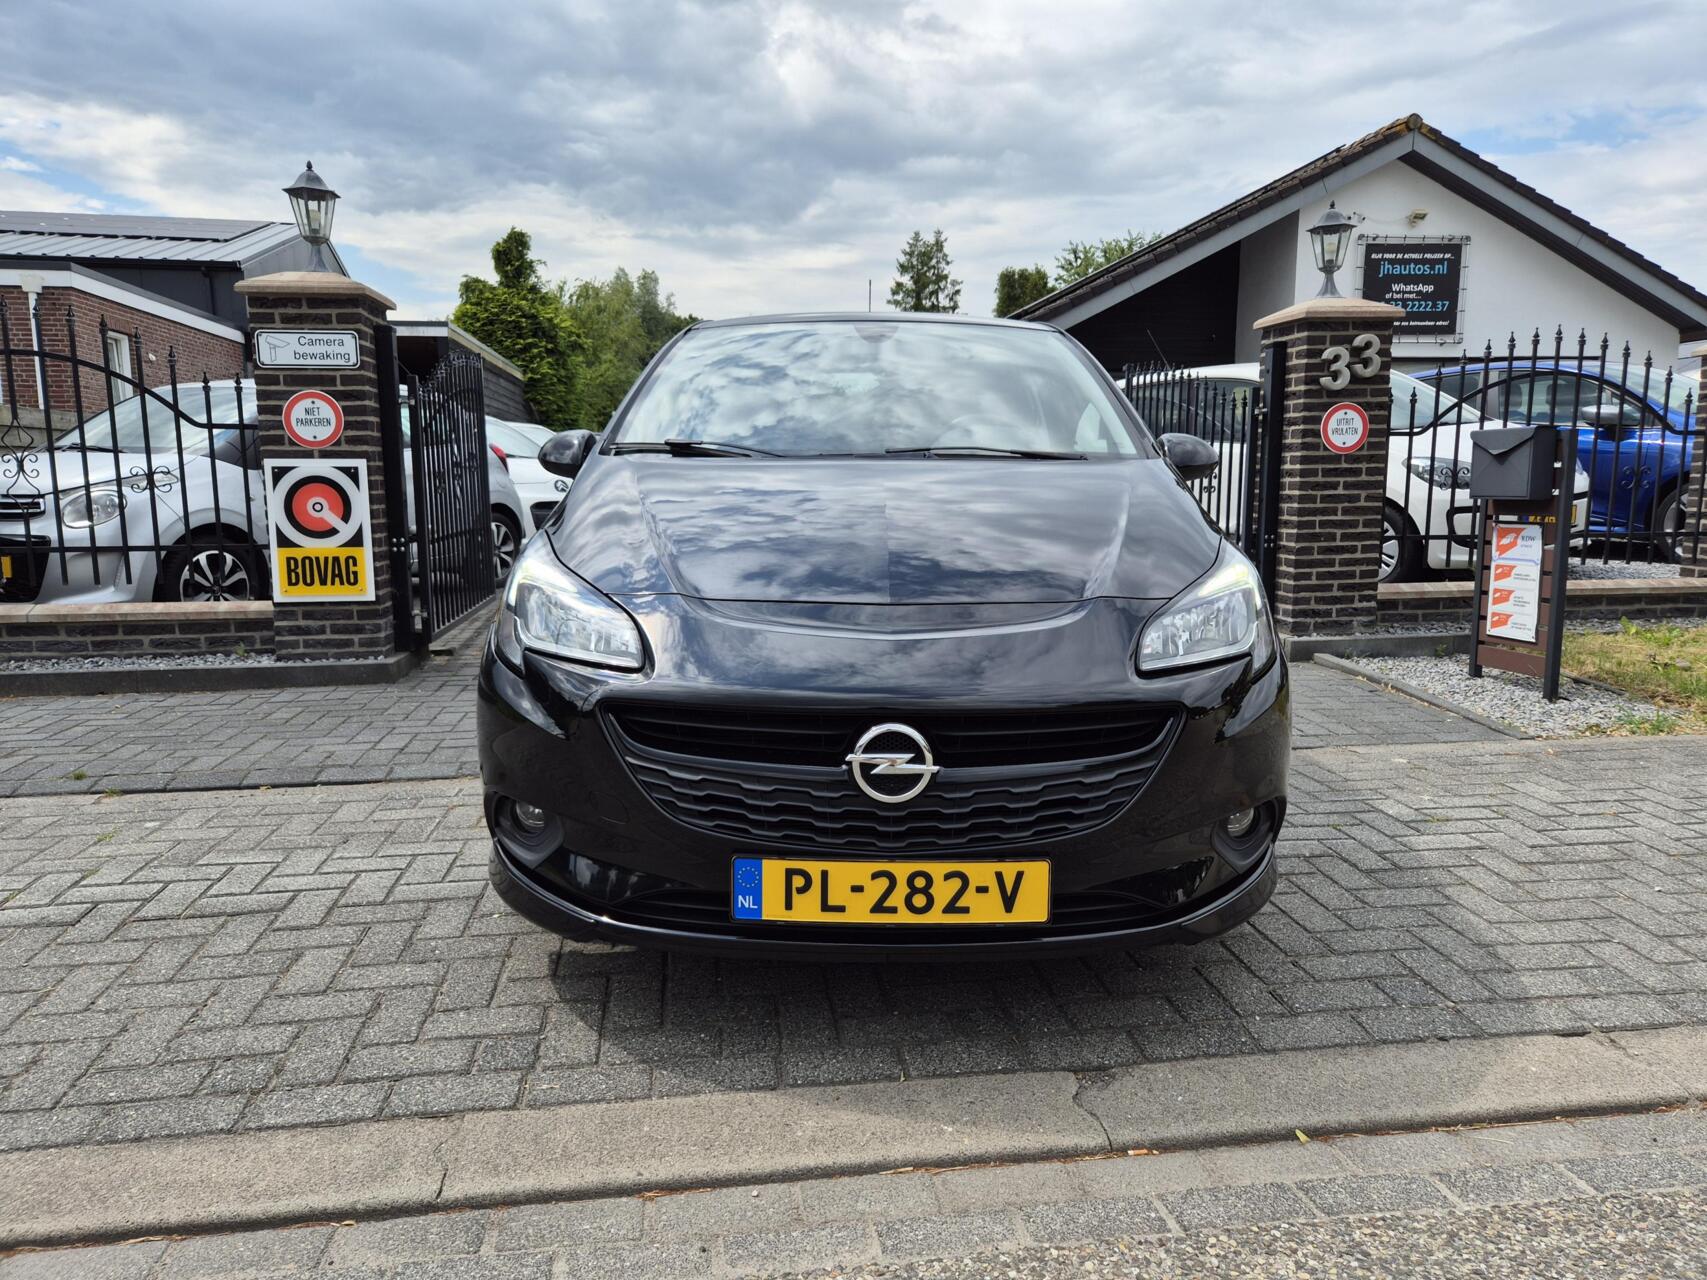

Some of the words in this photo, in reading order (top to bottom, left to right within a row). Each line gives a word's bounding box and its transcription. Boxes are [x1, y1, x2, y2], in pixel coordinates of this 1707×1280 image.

[1378, 261, 1448, 277] jhautos.nl
[1391, 283, 1434, 293] WhatsApp
[298, 336, 344, 347] Camera
[294, 350, 350, 363] bewaking
[1320, 333, 1381, 390] 33
[304, 407, 320, 416] NIET
[296, 417, 331, 427] PARKEREN
[1332, 427, 1358, 436] VRIJLATEN
[286, 556, 359, 586] BOVAG
[784, 867, 1024, 915] PL-282-V
[738, 895, 758, 908] NL
